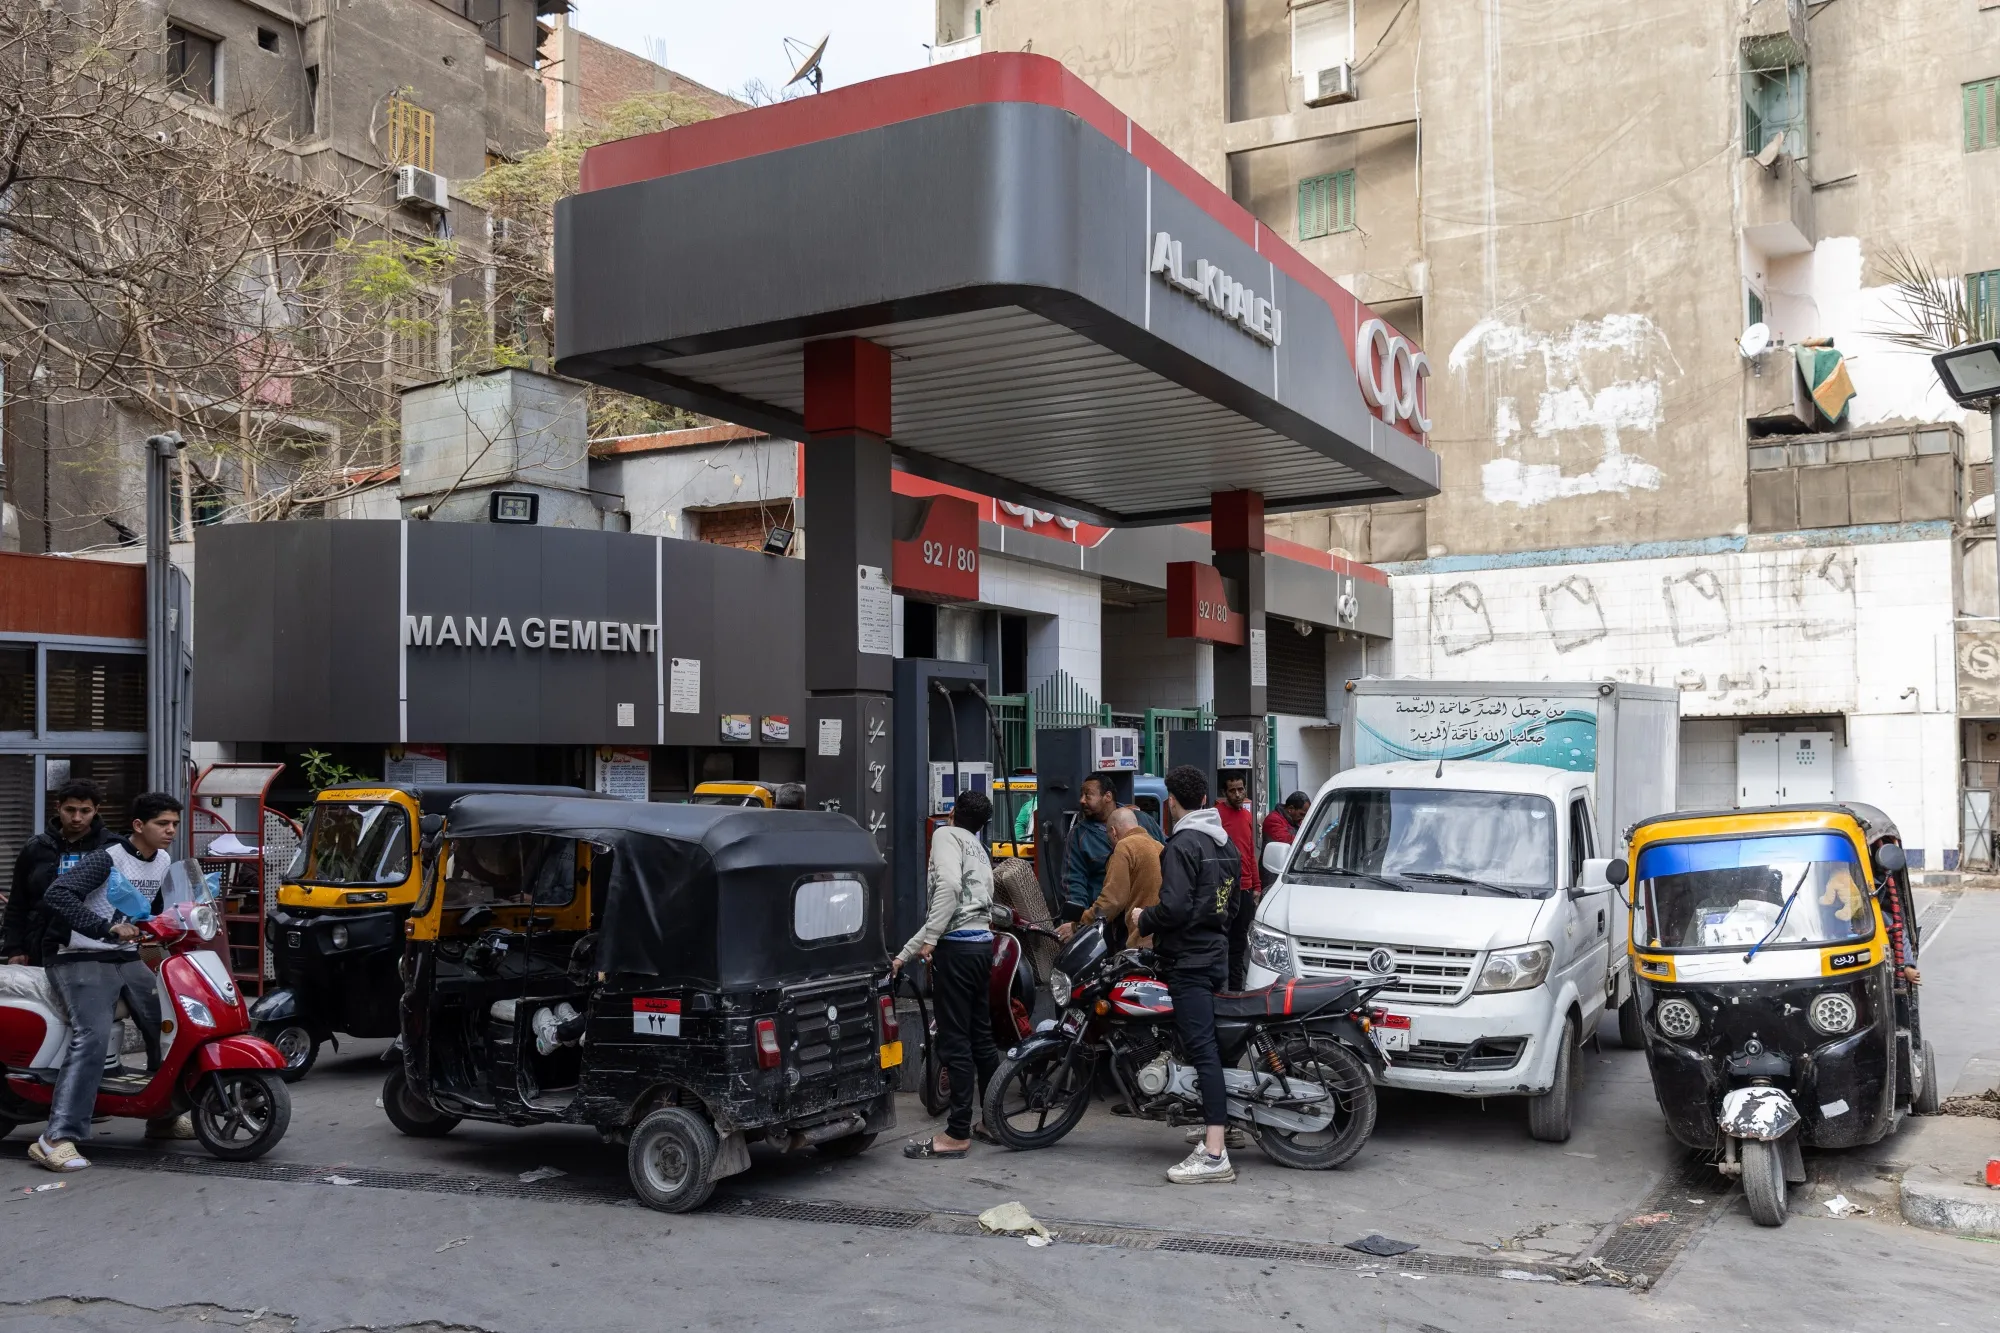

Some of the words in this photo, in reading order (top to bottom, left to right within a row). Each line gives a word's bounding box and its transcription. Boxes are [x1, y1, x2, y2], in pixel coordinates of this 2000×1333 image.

[924, 541, 942, 567] 92
[957, 548, 975, 572] 80
[1199, 600, 1209, 619] 92
[1217, 605, 1227, 622] 80
[406, 615, 661, 653] MANAGEMENT
[1115, 981, 1154, 989] BOXER
[648, 1014, 667, 1033] ٢٣
